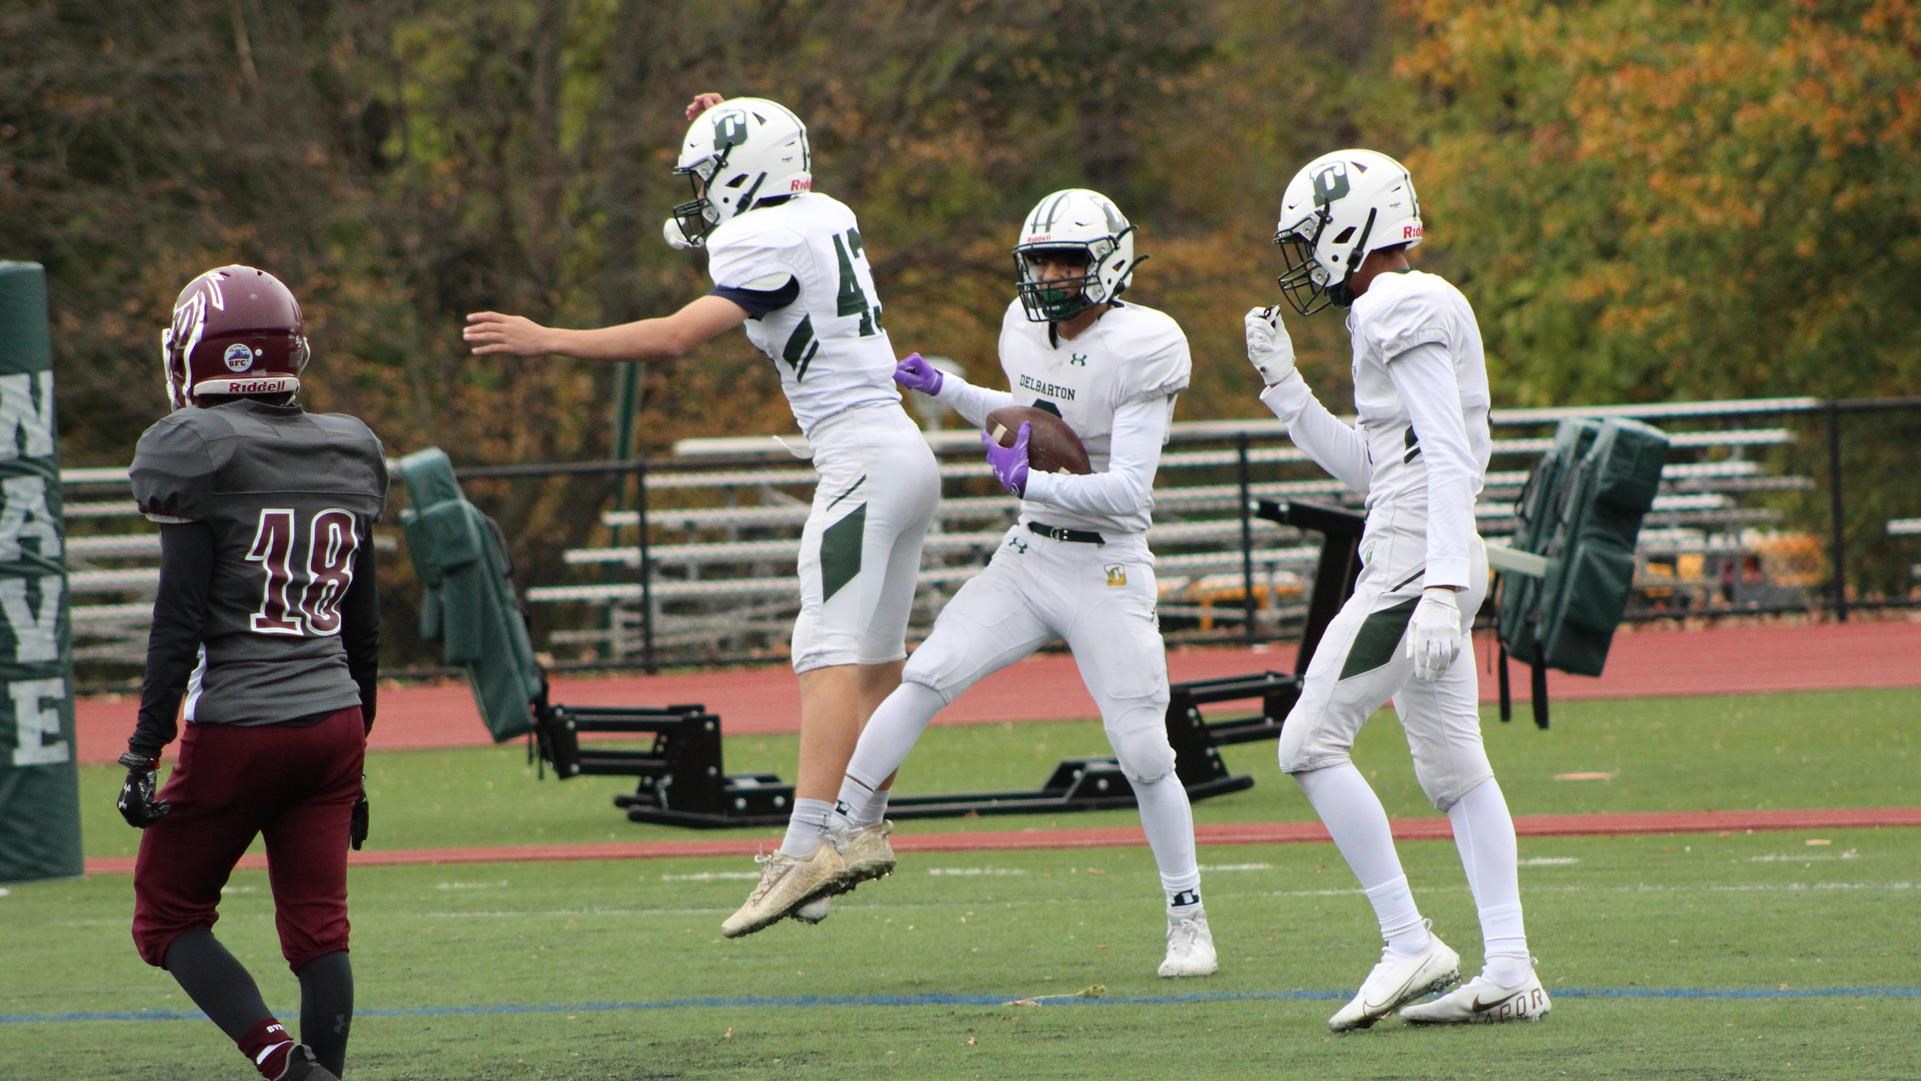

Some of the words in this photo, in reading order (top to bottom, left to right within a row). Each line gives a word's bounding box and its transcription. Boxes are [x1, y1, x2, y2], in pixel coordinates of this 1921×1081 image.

[229, 380, 285, 393] Riddell
[1019, 373, 1076, 401] DELBARTON
[245, 508, 358, 636] 18
[1484, 987, 1544, 1024] APOR
